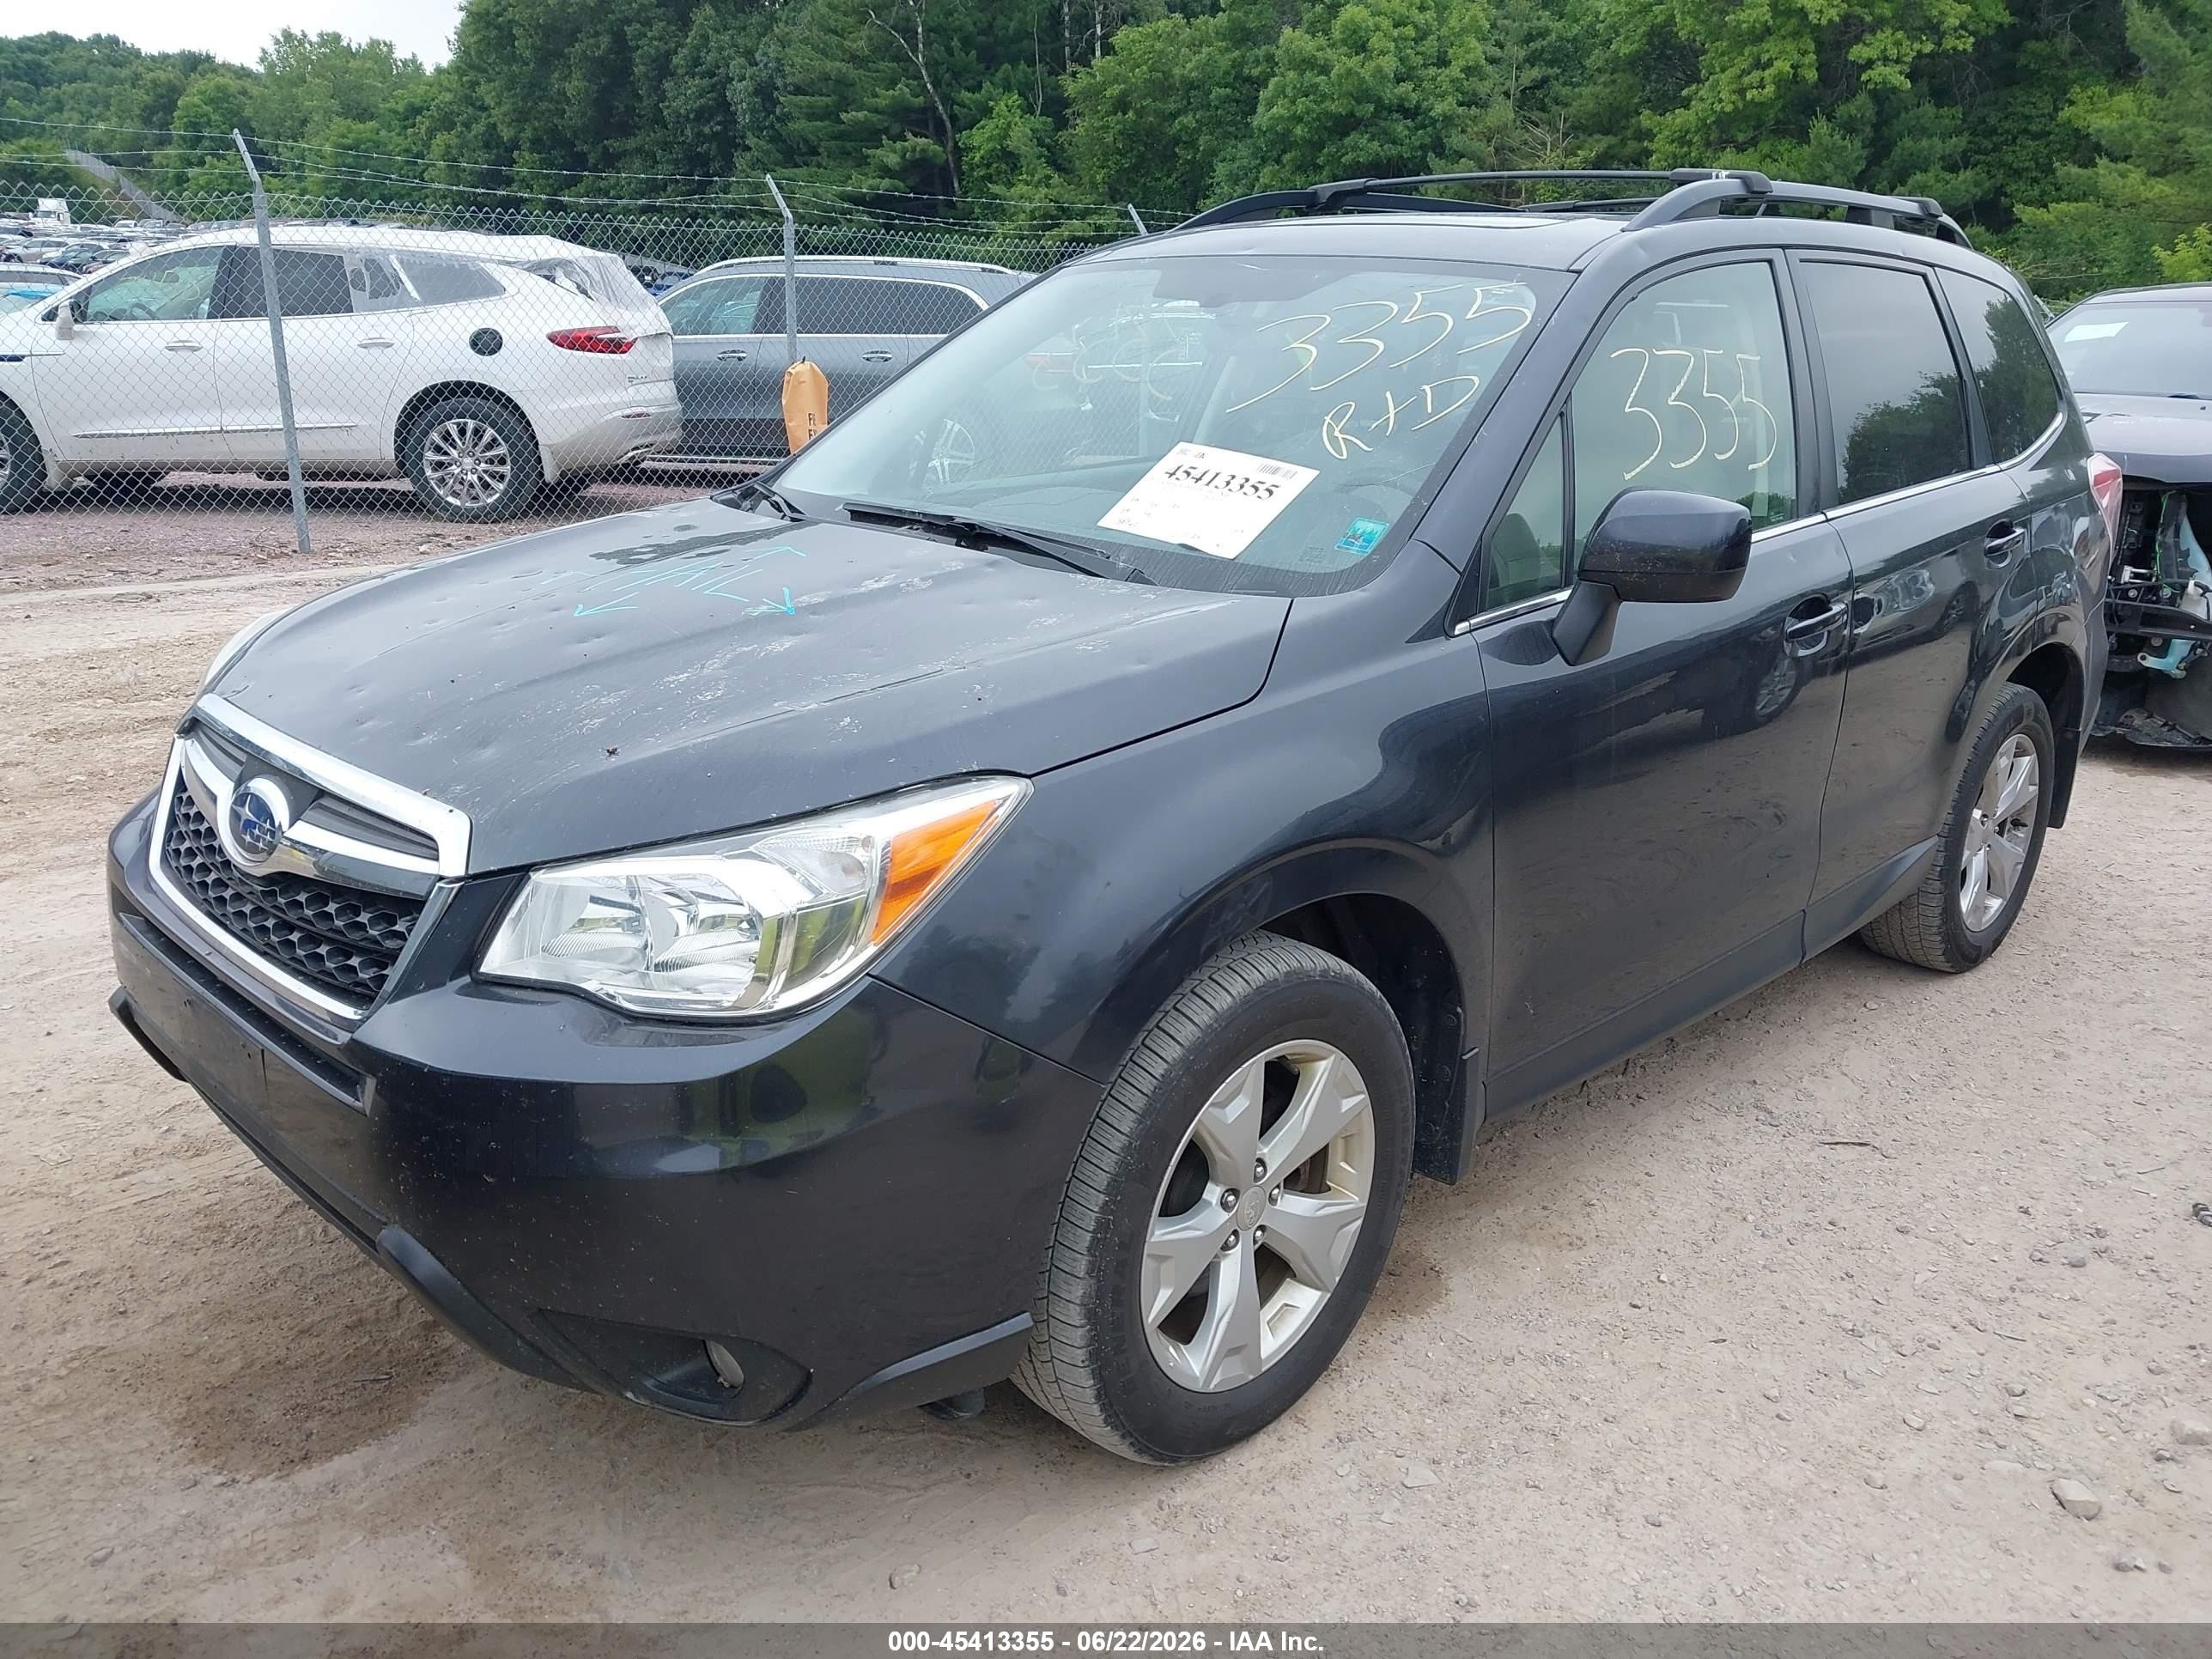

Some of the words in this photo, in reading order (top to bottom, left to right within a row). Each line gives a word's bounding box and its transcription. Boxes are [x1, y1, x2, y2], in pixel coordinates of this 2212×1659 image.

[1225, 282, 1533, 414] 3355
[1610, 348, 1778, 481] 3355
[1164, 464, 1282, 501] 45413355
